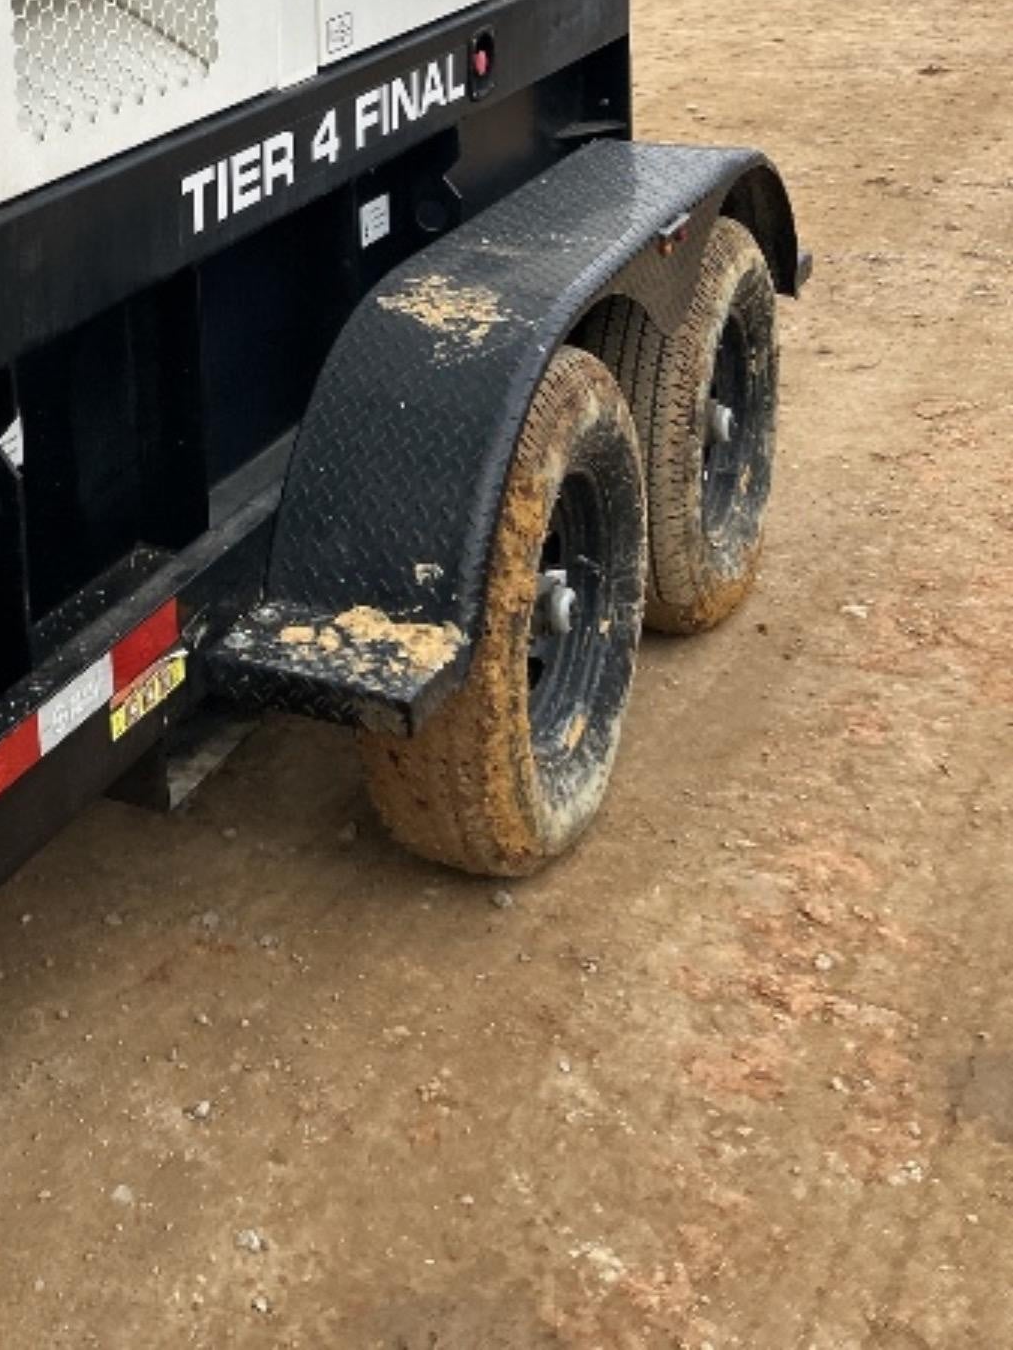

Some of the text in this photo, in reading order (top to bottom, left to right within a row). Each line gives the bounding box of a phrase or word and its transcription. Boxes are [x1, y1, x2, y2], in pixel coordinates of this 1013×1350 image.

[181, 53, 465, 234] TIER 4 FINAL
